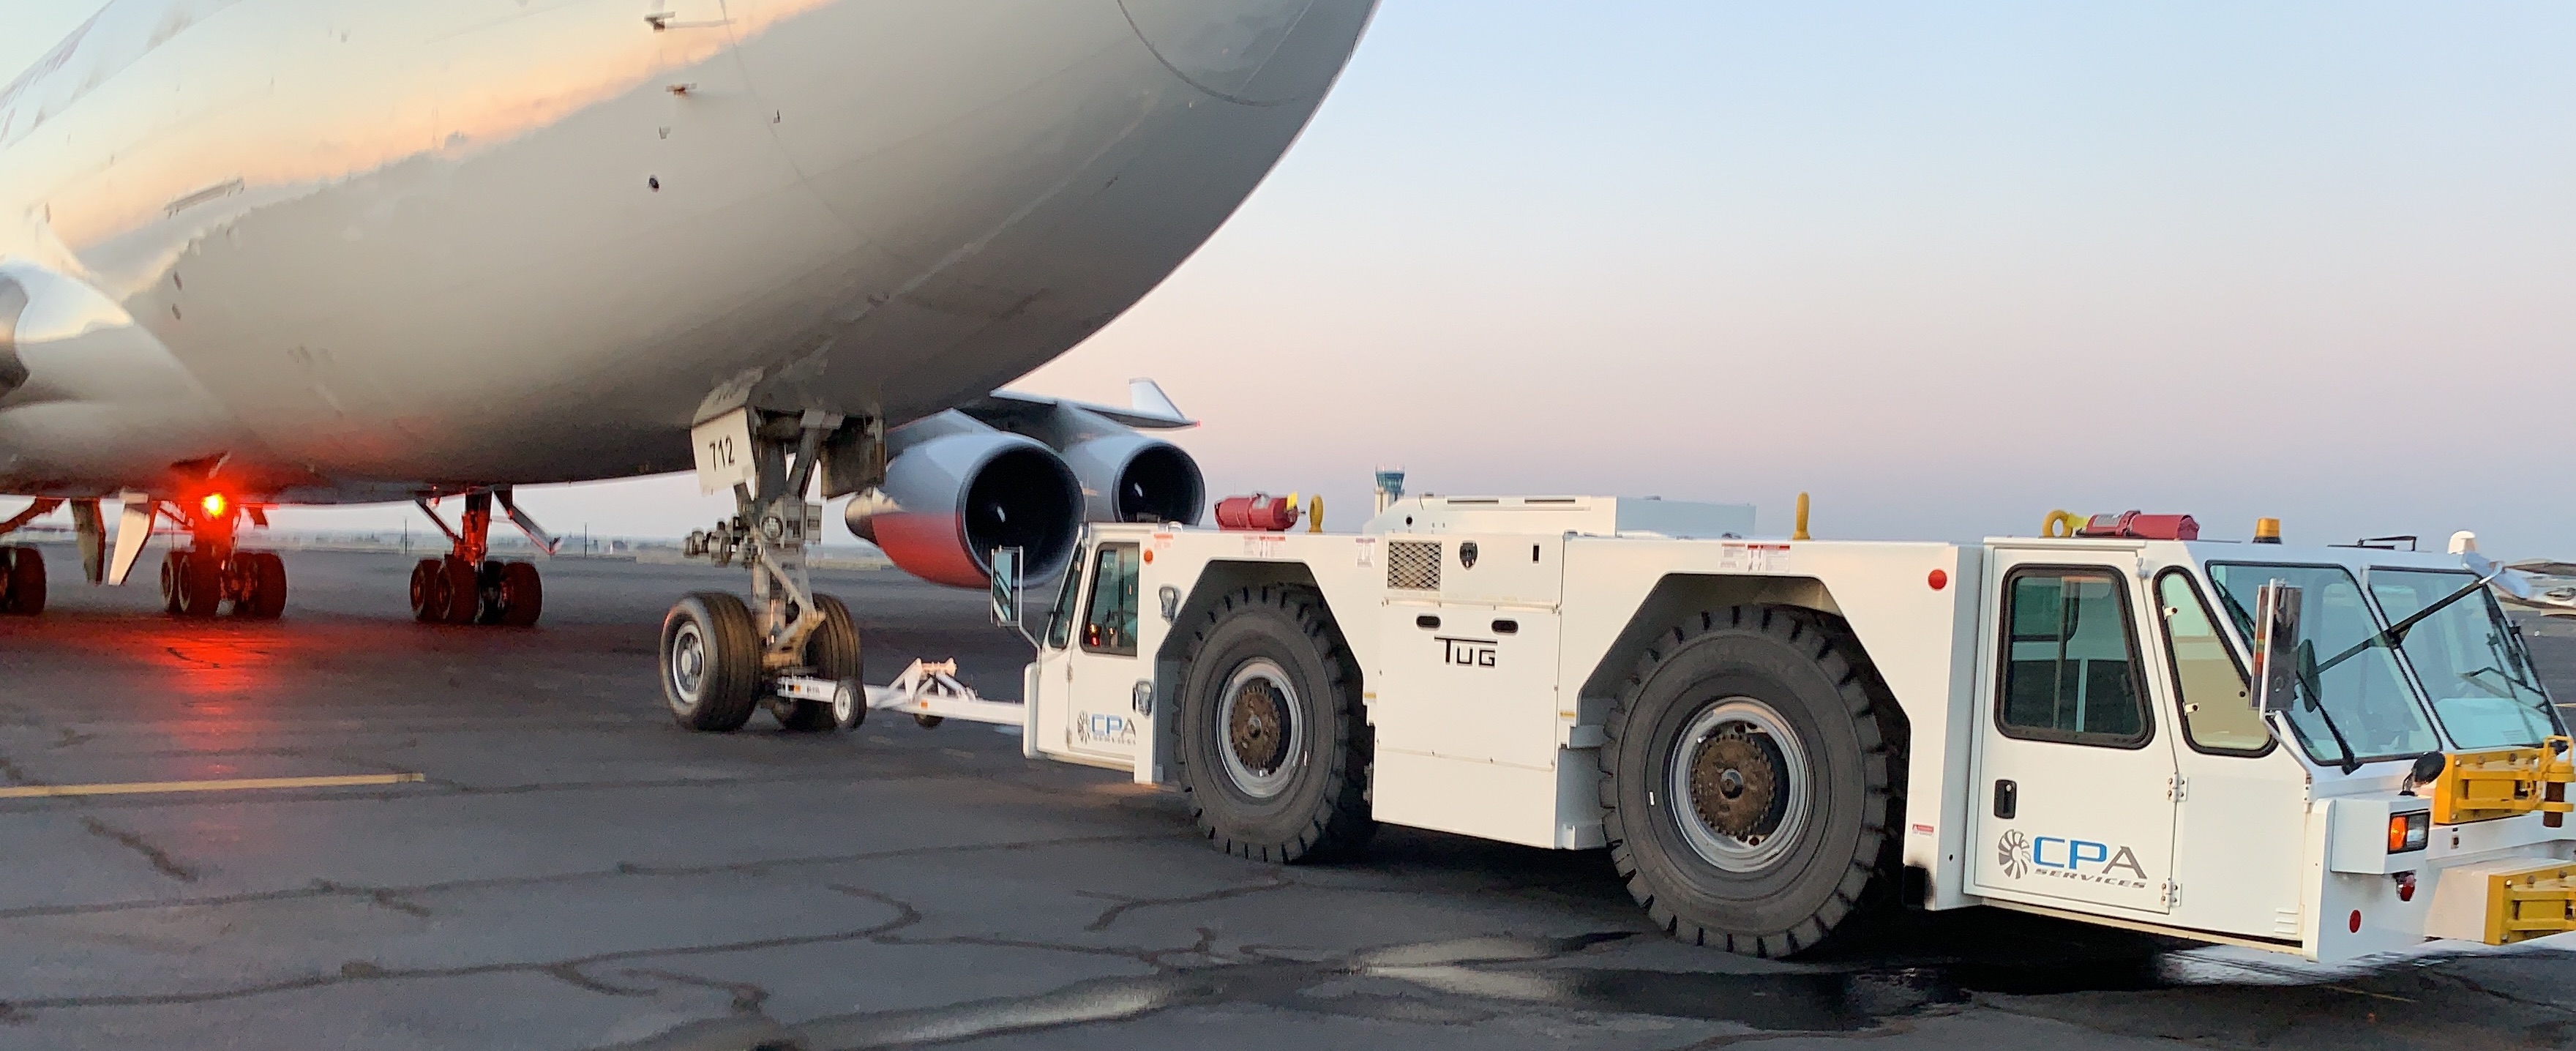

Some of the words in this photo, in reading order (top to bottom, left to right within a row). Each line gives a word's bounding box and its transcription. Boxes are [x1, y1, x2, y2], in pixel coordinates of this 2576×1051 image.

[709, 435, 735, 472] 712
[1091, 714, 1136, 738] CPA
[2034, 837, 2147, 879] CPA
[2034, 868, 2146, 889] SERVICES
